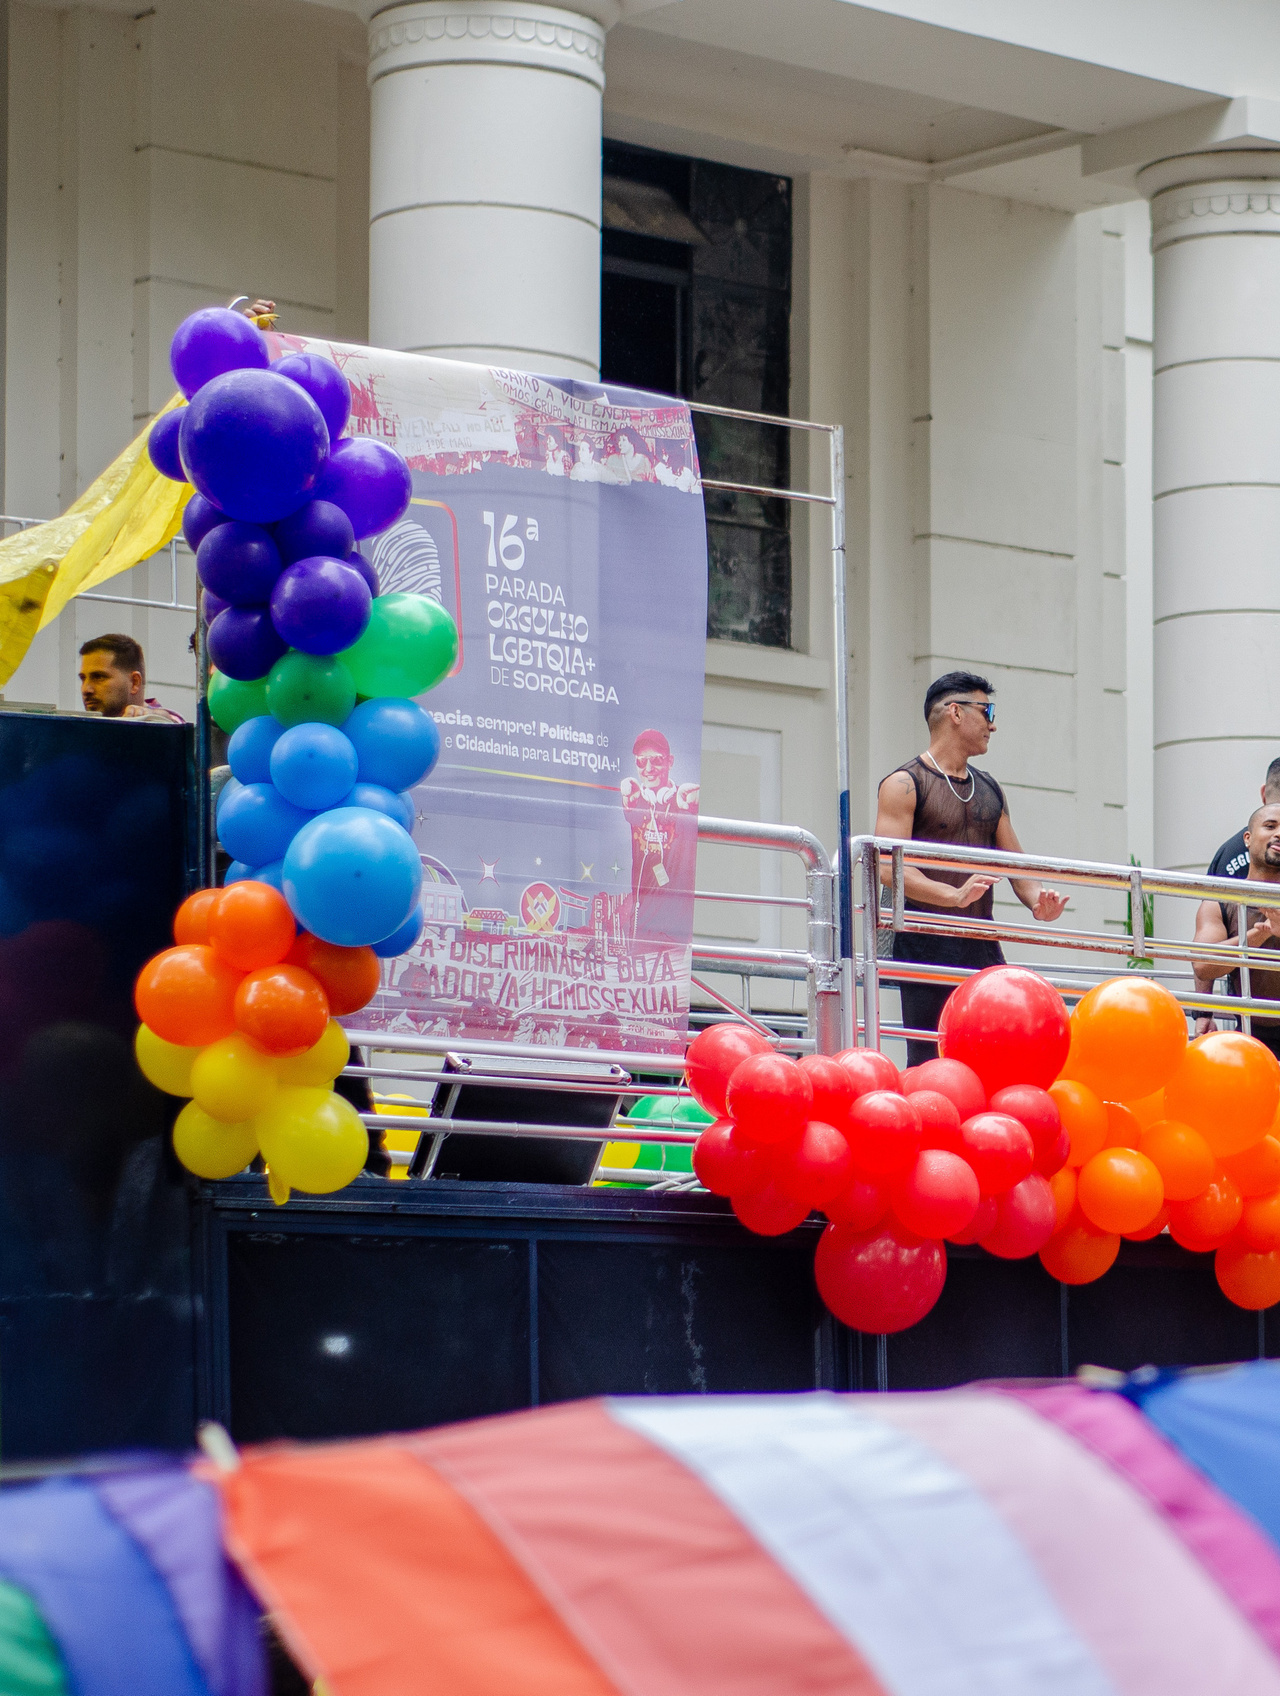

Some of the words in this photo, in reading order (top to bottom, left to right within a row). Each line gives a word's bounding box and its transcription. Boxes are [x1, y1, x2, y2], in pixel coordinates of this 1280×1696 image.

[535, 397, 562, 419] GRUPO
[546, 387, 555, 402] A
[449, 437, 473, 449] MAIO
[485, 573, 566, 607] PARADA
[487, 600, 589, 643] ORGULHO
[489, 633, 596, 676] LGBTQIA+
[491, 666, 510, 687] DE
[513, 670, 620, 705] SOROCABA
[476, 715, 537, 736] sempre!
[539, 721, 595, 745] Políticas
[596, 731, 609, 748] de
[444, 736, 453, 749] e
[455, 733, 520, 758] Cidadania
[522, 745, 550, 762] para
[552, 747, 621, 774] LGBTQIA+!
[419, 938, 435, 958] A
[531, 977, 688, 1014] HOMOSSEXUAL
